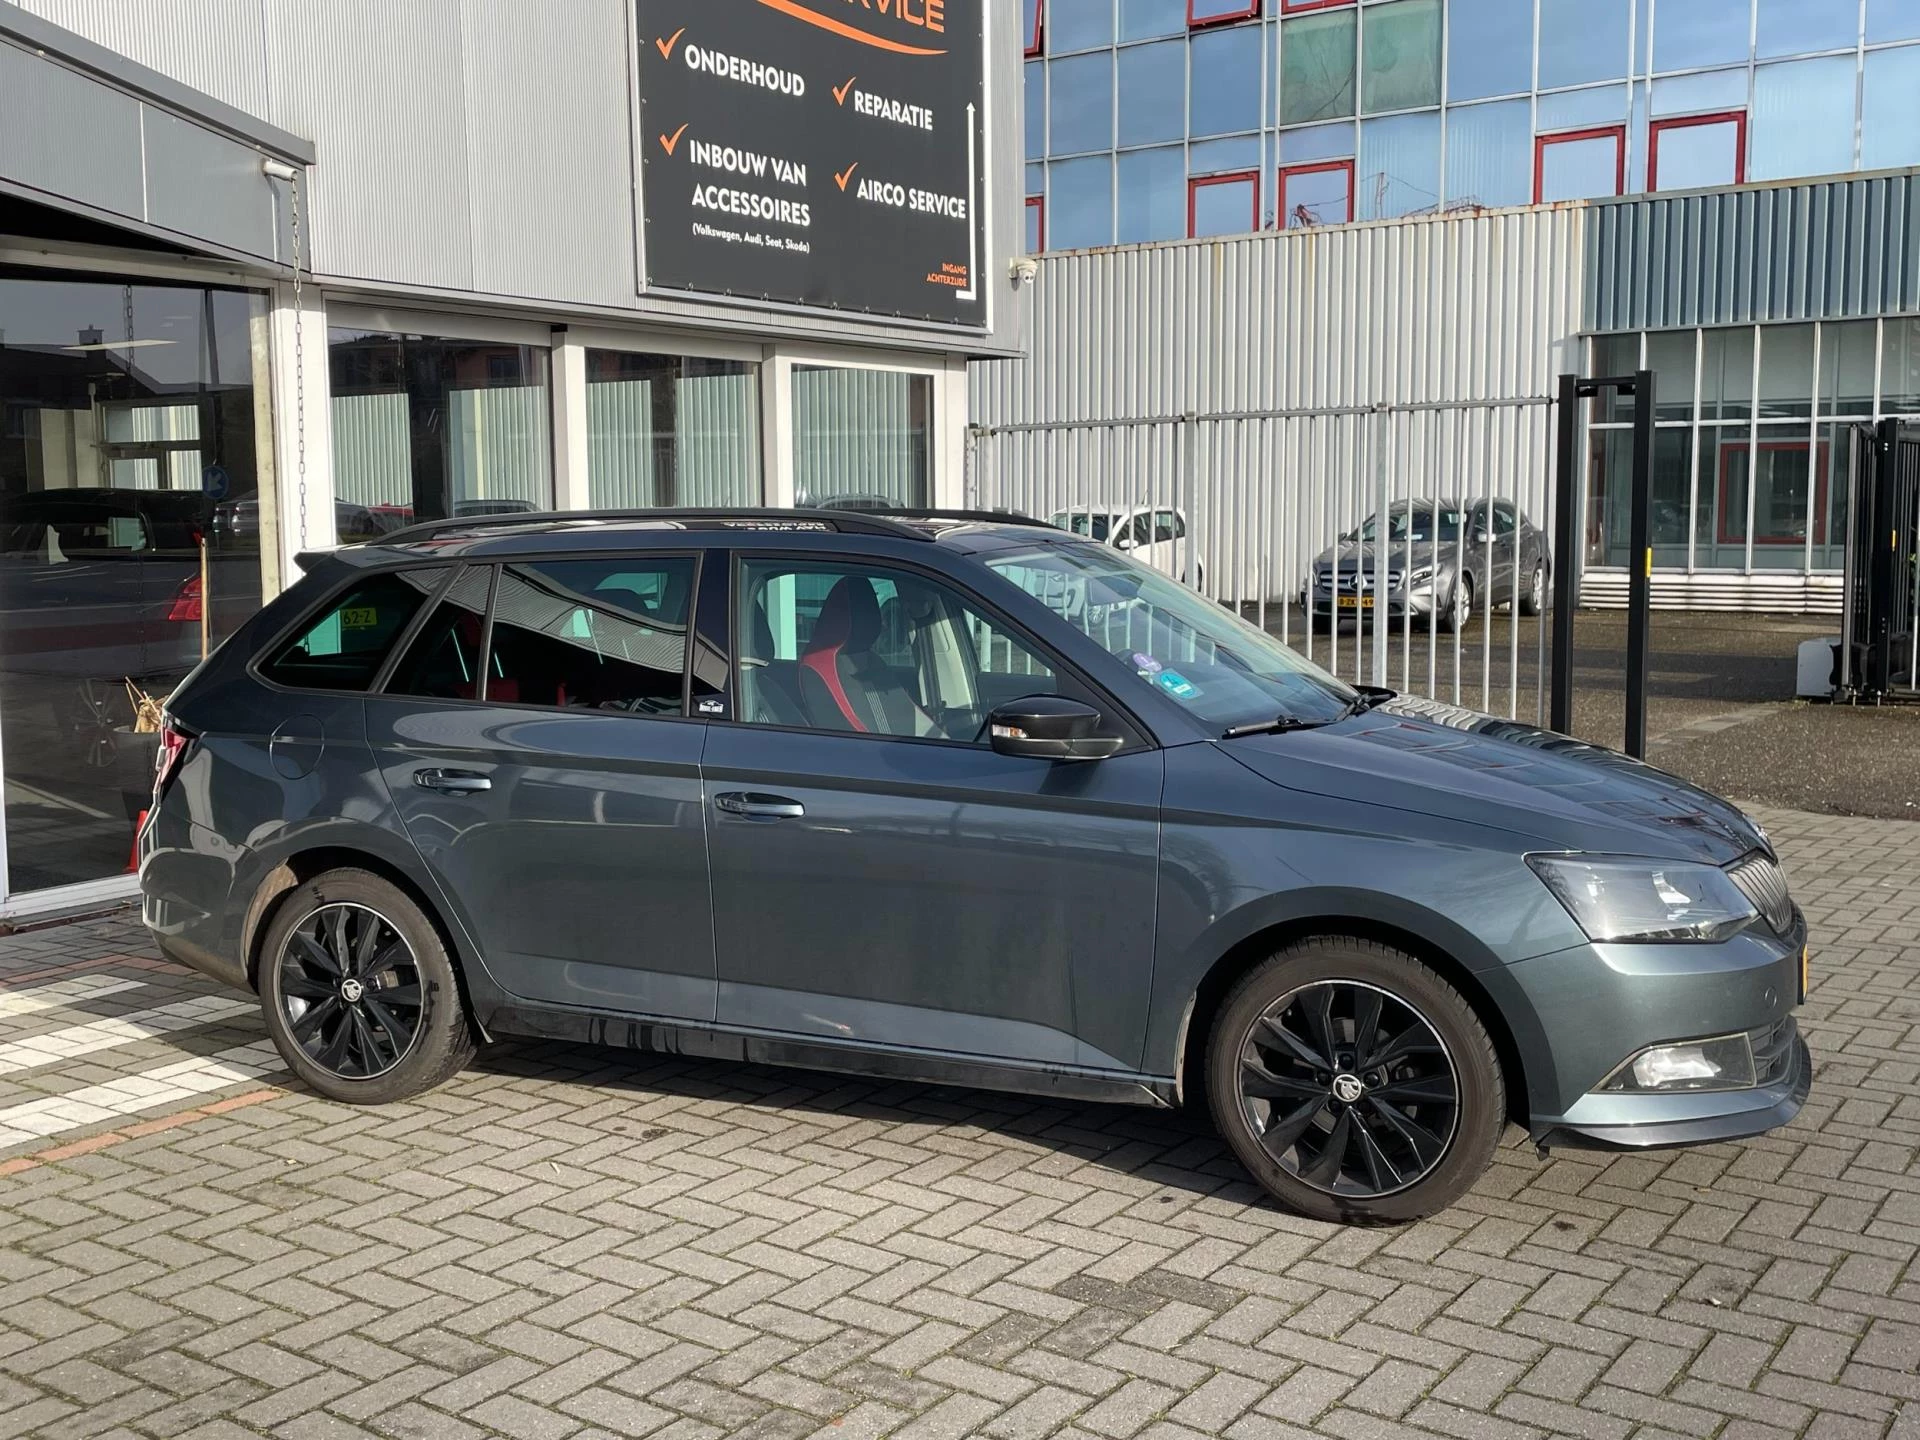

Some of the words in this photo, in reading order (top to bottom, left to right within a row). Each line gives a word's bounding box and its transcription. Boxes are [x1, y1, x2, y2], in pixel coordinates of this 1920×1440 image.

[684, 44, 805, 96] ONDERHOUD
[854, 90, 933, 131] REPARATIE
[689, 139, 768, 178] INBOUW
[770, 157, 807, 187] VAN
[691, 182, 811, 226] ACCESSOIRES
[857, 177, 905, 207] AIRCO
[908, 187, 967, 219] SERVICE
[692, 222, 743, 243] (Volkswagen,
[744, 232, 764, 246] Audi,
[765, 234, 784, 249] Seat,
[785, 238, 810, 254] Skoda)
[942, 262, 967, 275] INGANG
